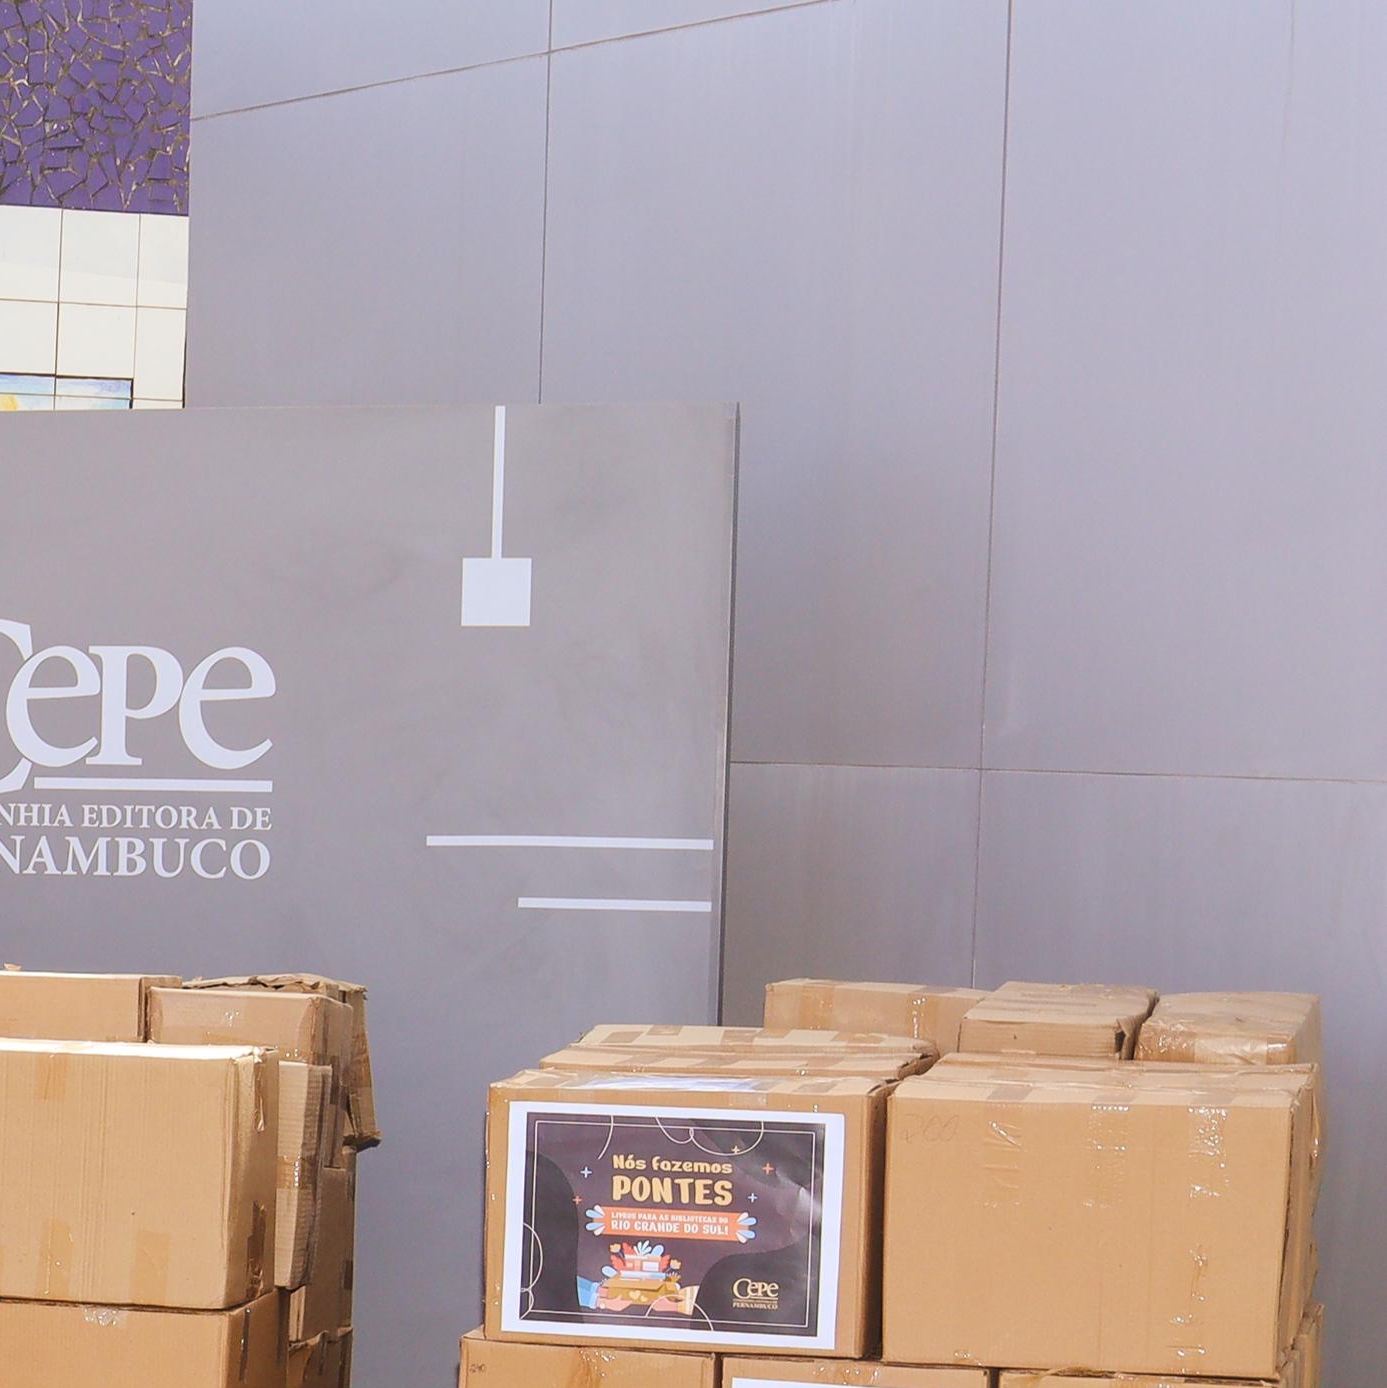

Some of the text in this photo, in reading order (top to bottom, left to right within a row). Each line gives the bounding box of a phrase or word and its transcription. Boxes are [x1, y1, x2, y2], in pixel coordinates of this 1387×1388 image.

[81, 804, 222, 829] EDITORA
[230, 807, 272, 831] DE
[612, 1154, 733, 1174] Nós fazemos
[611, 1174, 732, 1206] PONTES
[610, 1218, 729, 1235] RIO GRANDE DO SUL!
